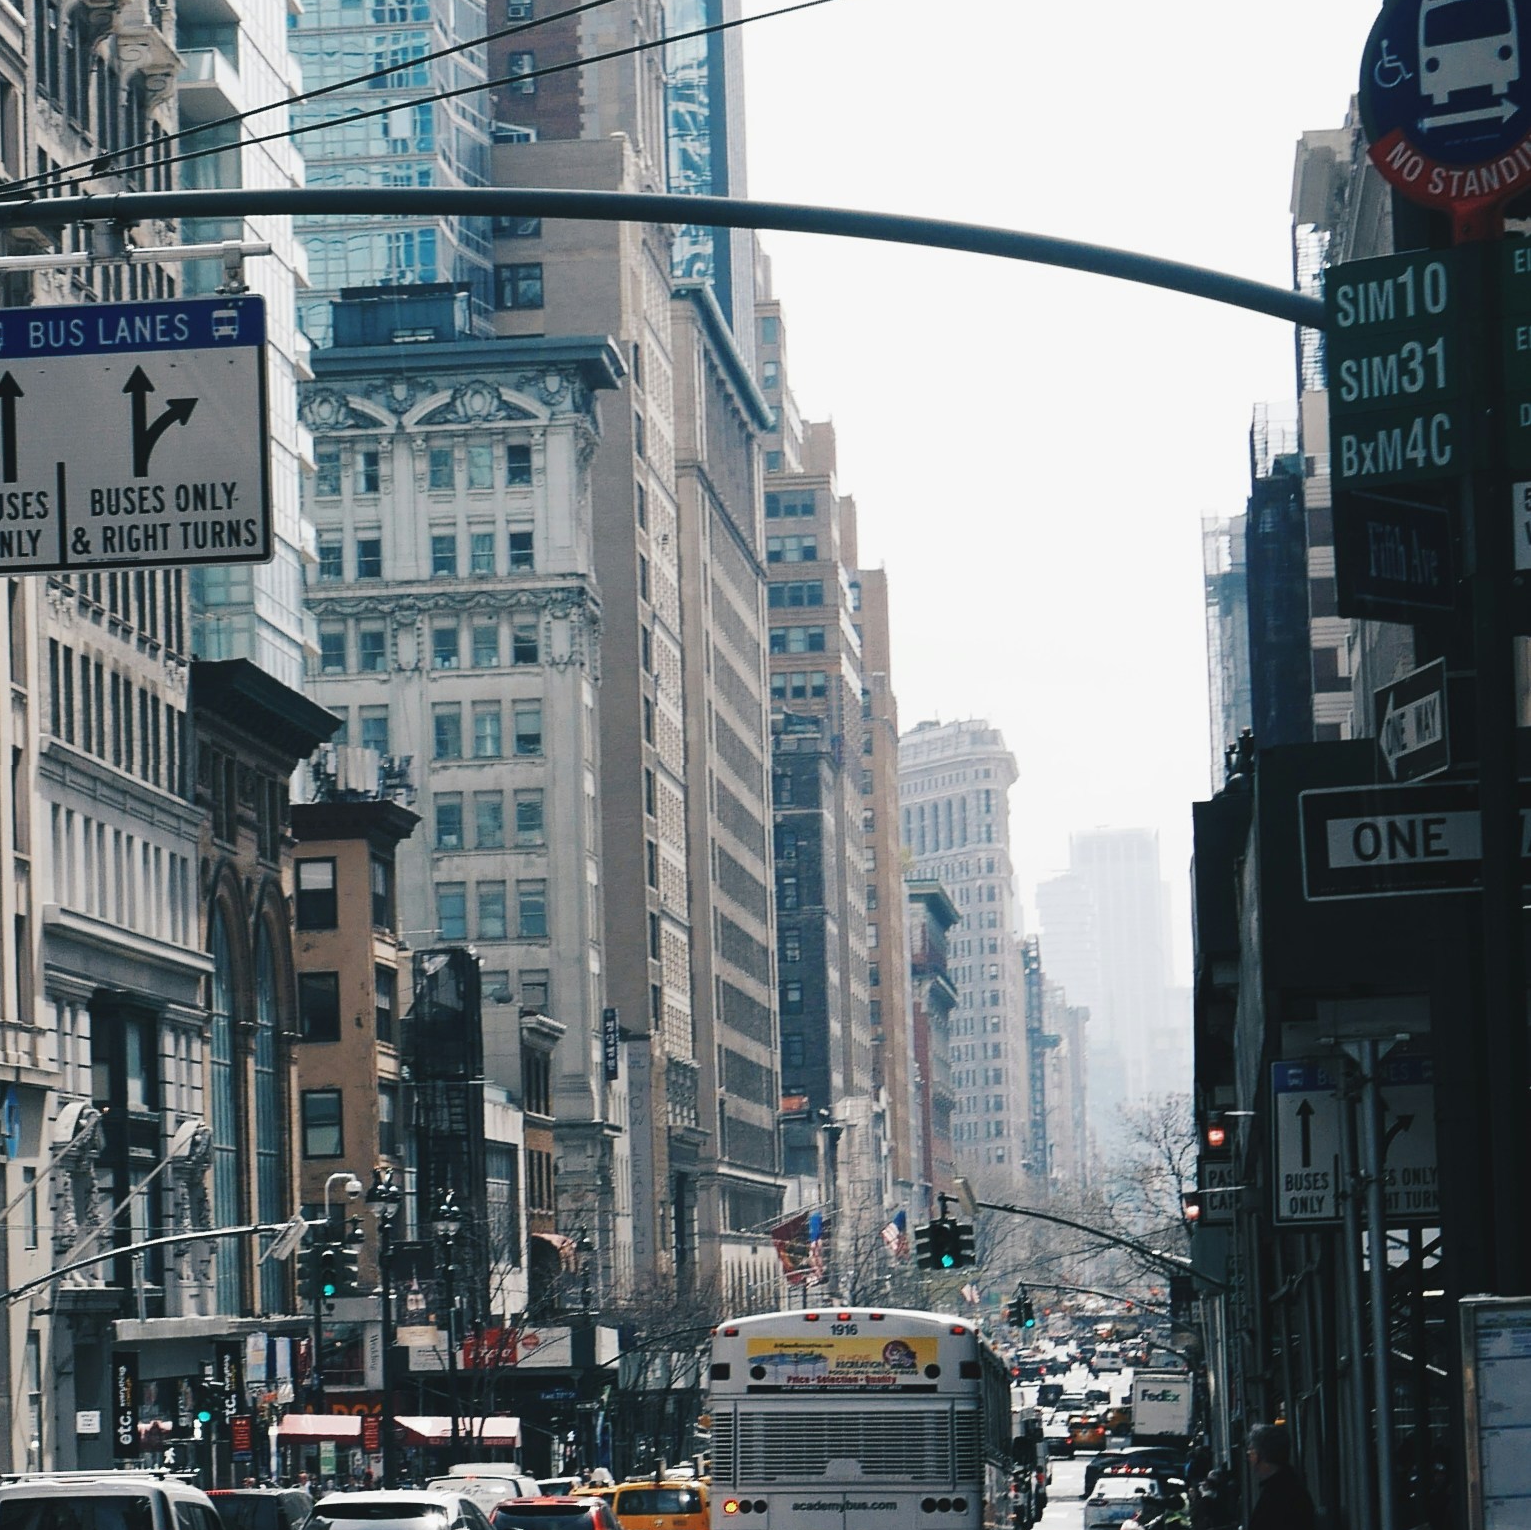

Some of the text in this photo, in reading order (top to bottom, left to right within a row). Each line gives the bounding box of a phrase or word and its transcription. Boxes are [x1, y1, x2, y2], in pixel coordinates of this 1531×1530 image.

[1386, 140, 1425, 183] NO
[1336, 261, 1448, 328] SIM10
[29, 314, 189, 348] BUS LANES
[1341, 336, 1448, 403] SIM31
[1341, 412, 1453, 478] BxM4C
[90, 482, 237, 517] BUSES ONLY
[72, 519, 258, 556] & RIGHT TURNS
[1368, 521, 1439, 587] Fifth Ave
[1415, 695, 1442, 742] WAY
[1353, 817, 1450, 863] ONE
[1285, 1173, 1329, 1191] BUSES
[1290, 1195, 1325, 1215] ONLY
[831, 1325, 858, 1335] 1916
[816, 1376, 859, 1384] Selection
[1141, 1389, 1181, 1402] FedEx
[118, 1411, 133, 1445] etc.
[792, 1502, 897, 1512] academybus.com
